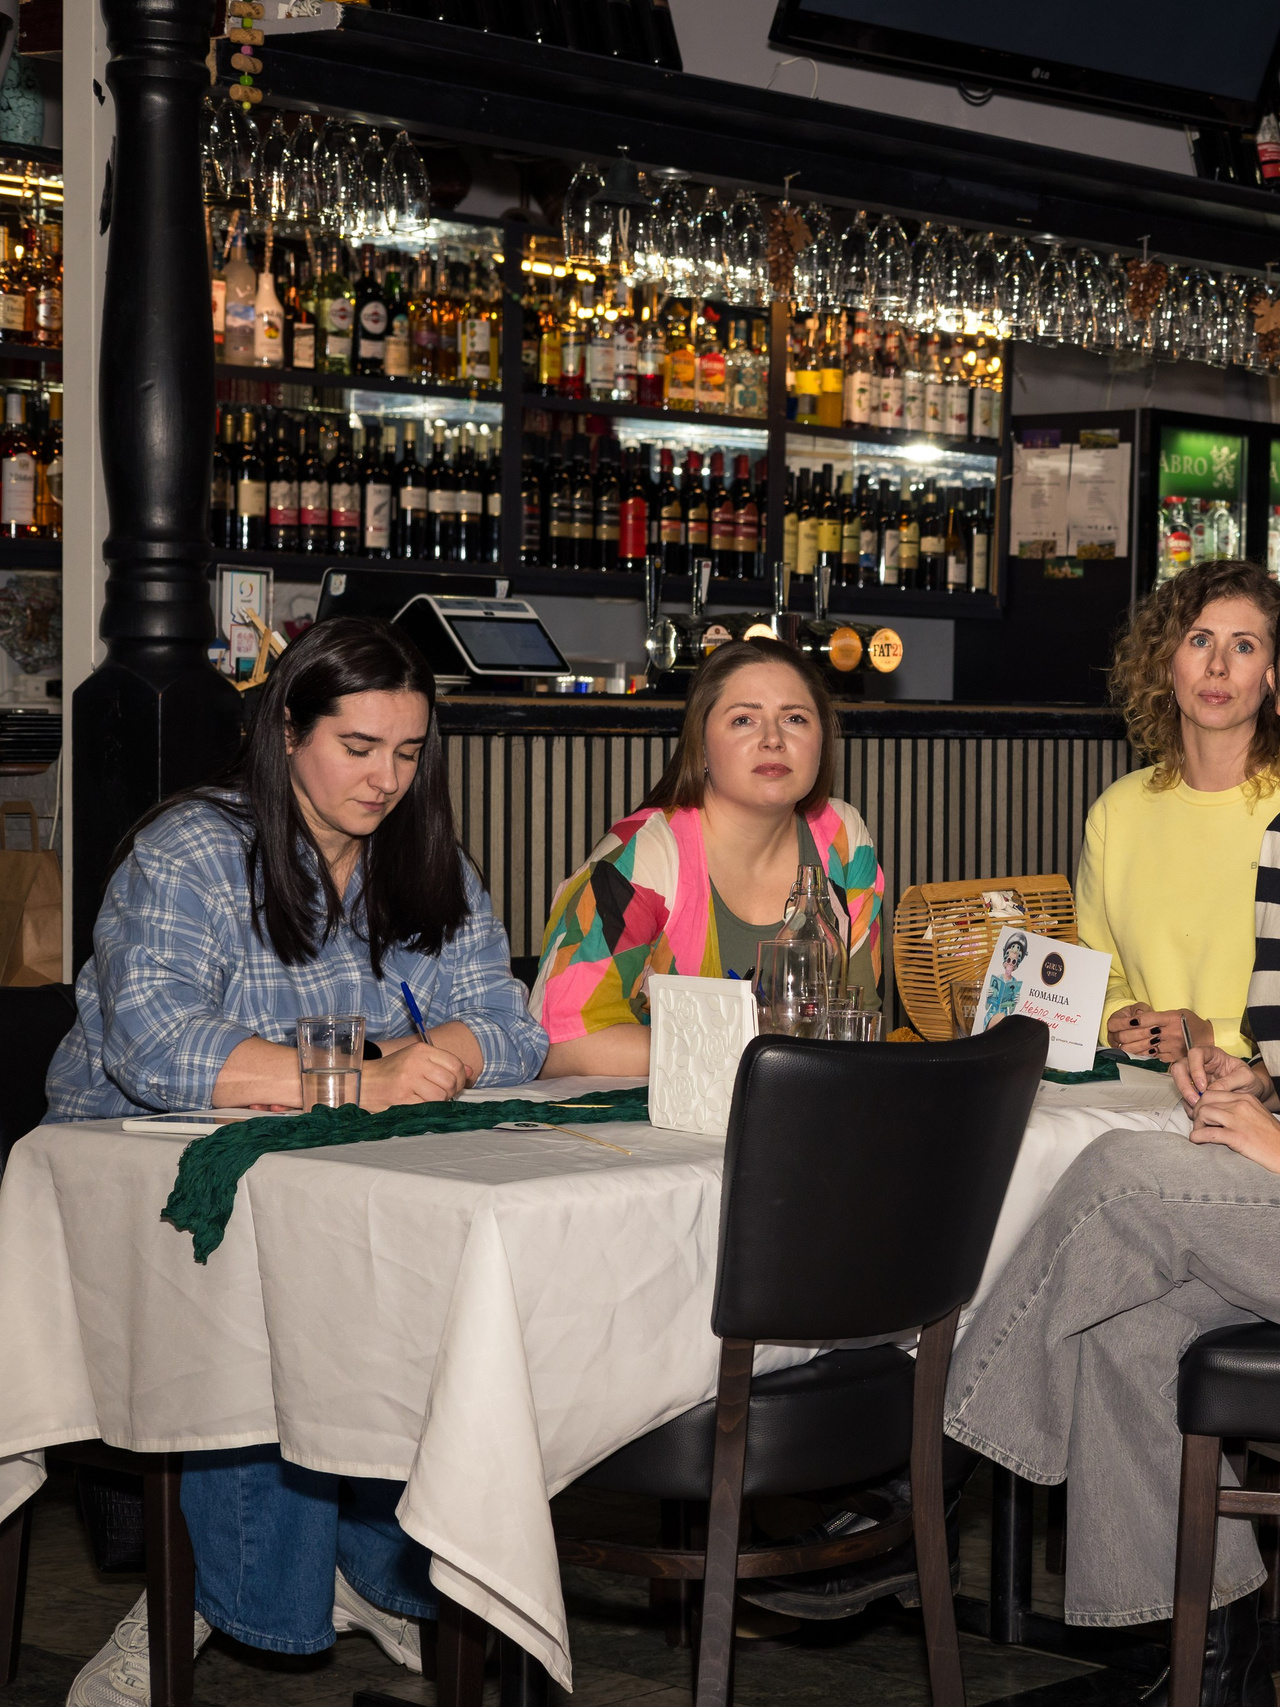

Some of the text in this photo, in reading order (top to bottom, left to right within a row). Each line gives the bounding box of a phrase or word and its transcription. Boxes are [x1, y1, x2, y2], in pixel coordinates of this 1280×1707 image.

[873, 643, 902, 657] FAT21
[1029, 988, 1070, 1006] КОМАНДА
[963, 1005, 978, 1018] FA
